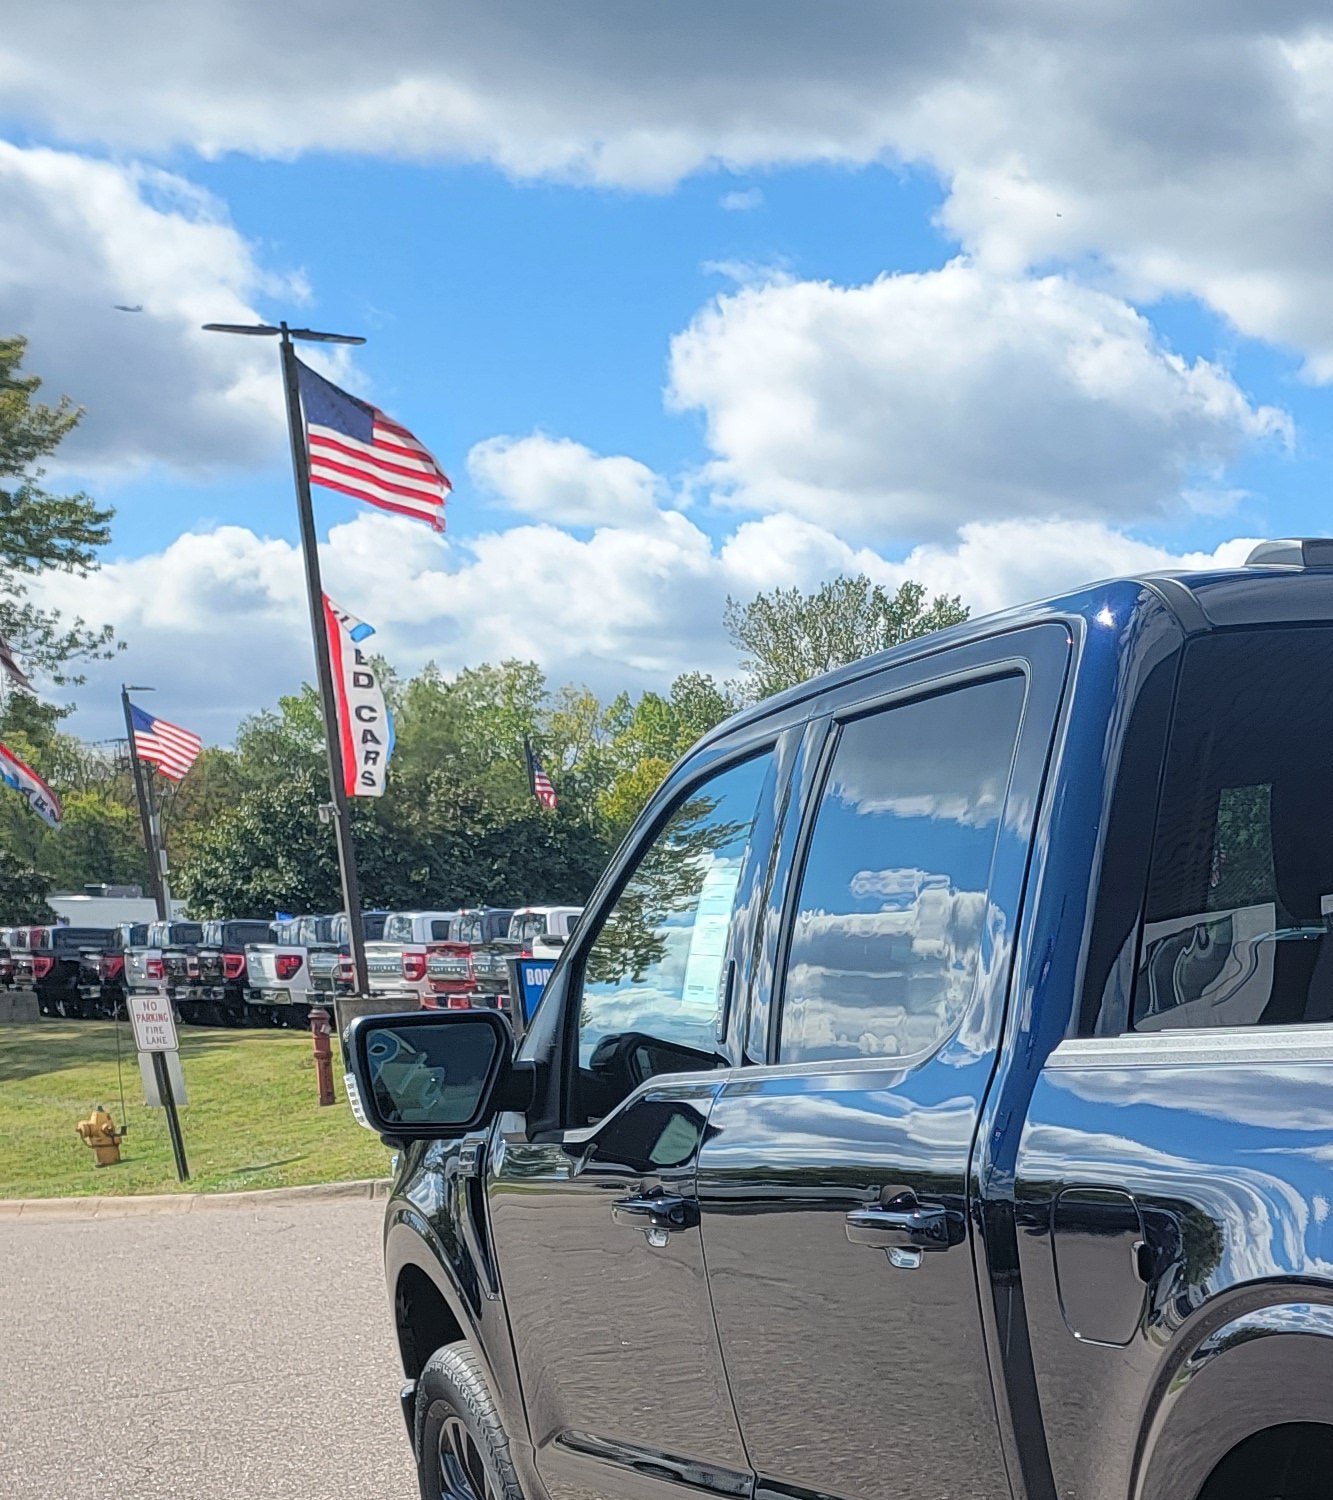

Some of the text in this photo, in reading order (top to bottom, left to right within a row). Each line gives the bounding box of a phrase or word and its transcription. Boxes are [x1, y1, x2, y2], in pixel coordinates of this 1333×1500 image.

[355, 706, 382, 787] CARS
[526, 968, 553, 986] BOD
[142, 1001, 158, 1012] NO
[136, 1012, 169, 1024] PARKING
[145, 1026, 165, 1035] FIRE
[146, 1036, 168, 1045] LANE
